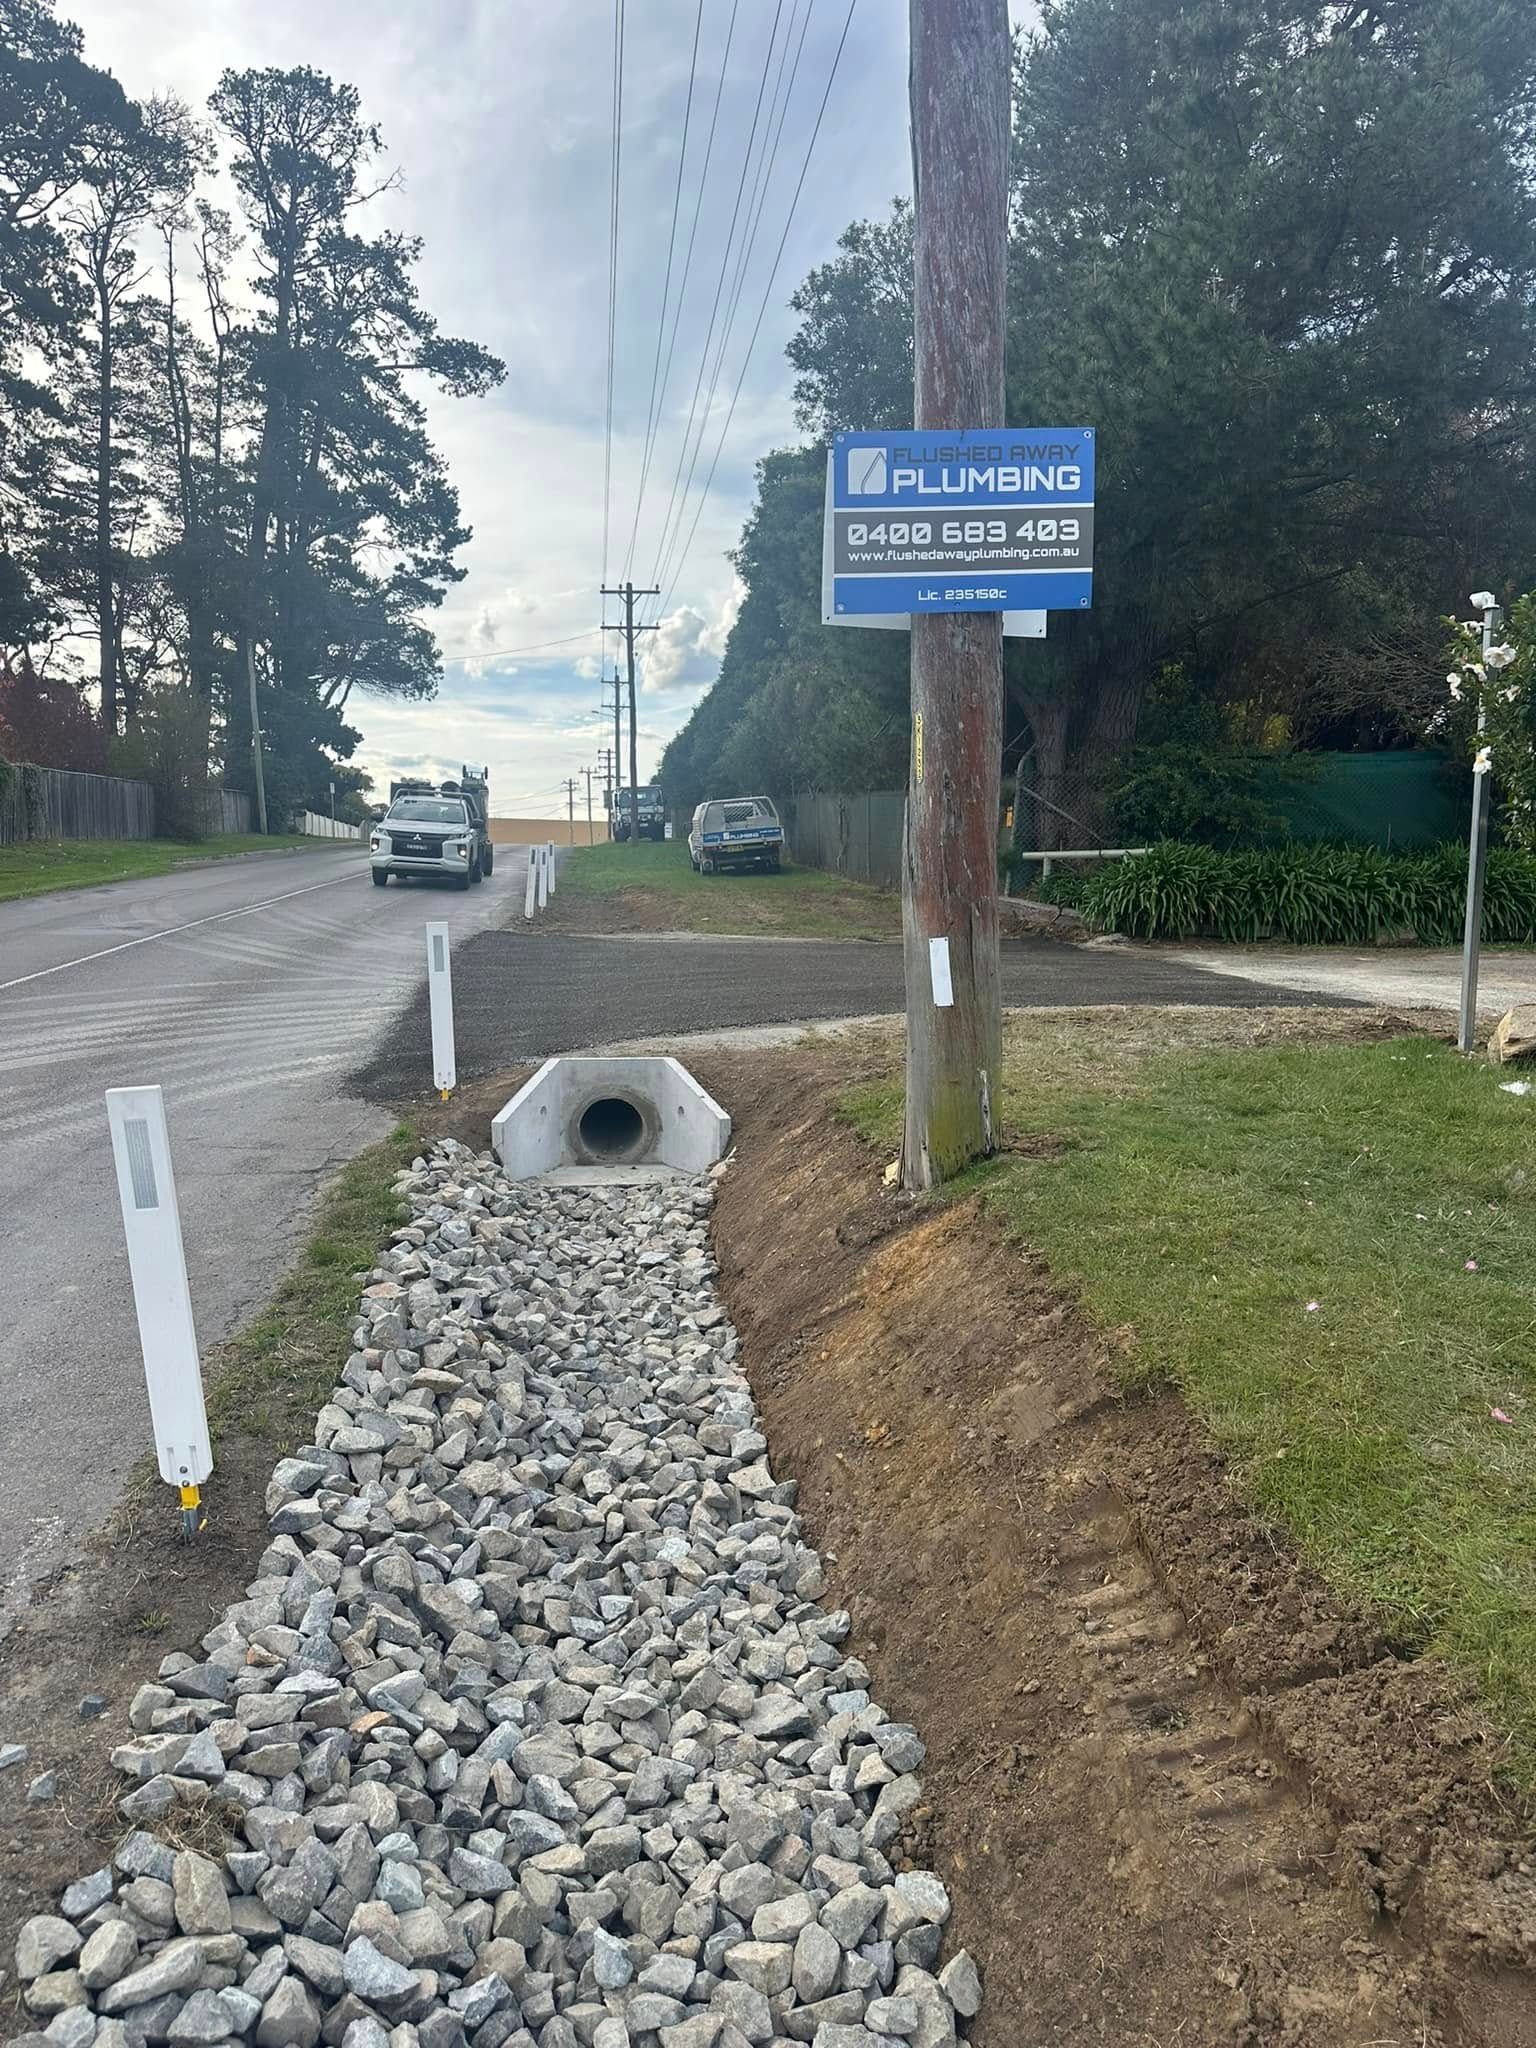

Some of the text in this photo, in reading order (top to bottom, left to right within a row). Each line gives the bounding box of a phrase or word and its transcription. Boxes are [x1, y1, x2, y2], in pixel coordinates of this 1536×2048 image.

[893, 444, 1080, 463] FLUSHED AWAY
[893, 466, 1080, 494] PLUMBING
[847, 519, 1080, 545] 0400 683 403
[848, 547, 1080, 562] www.flushedawayplumbing.com.au
[918, 588, 1007, 601] Lic. 235150c
